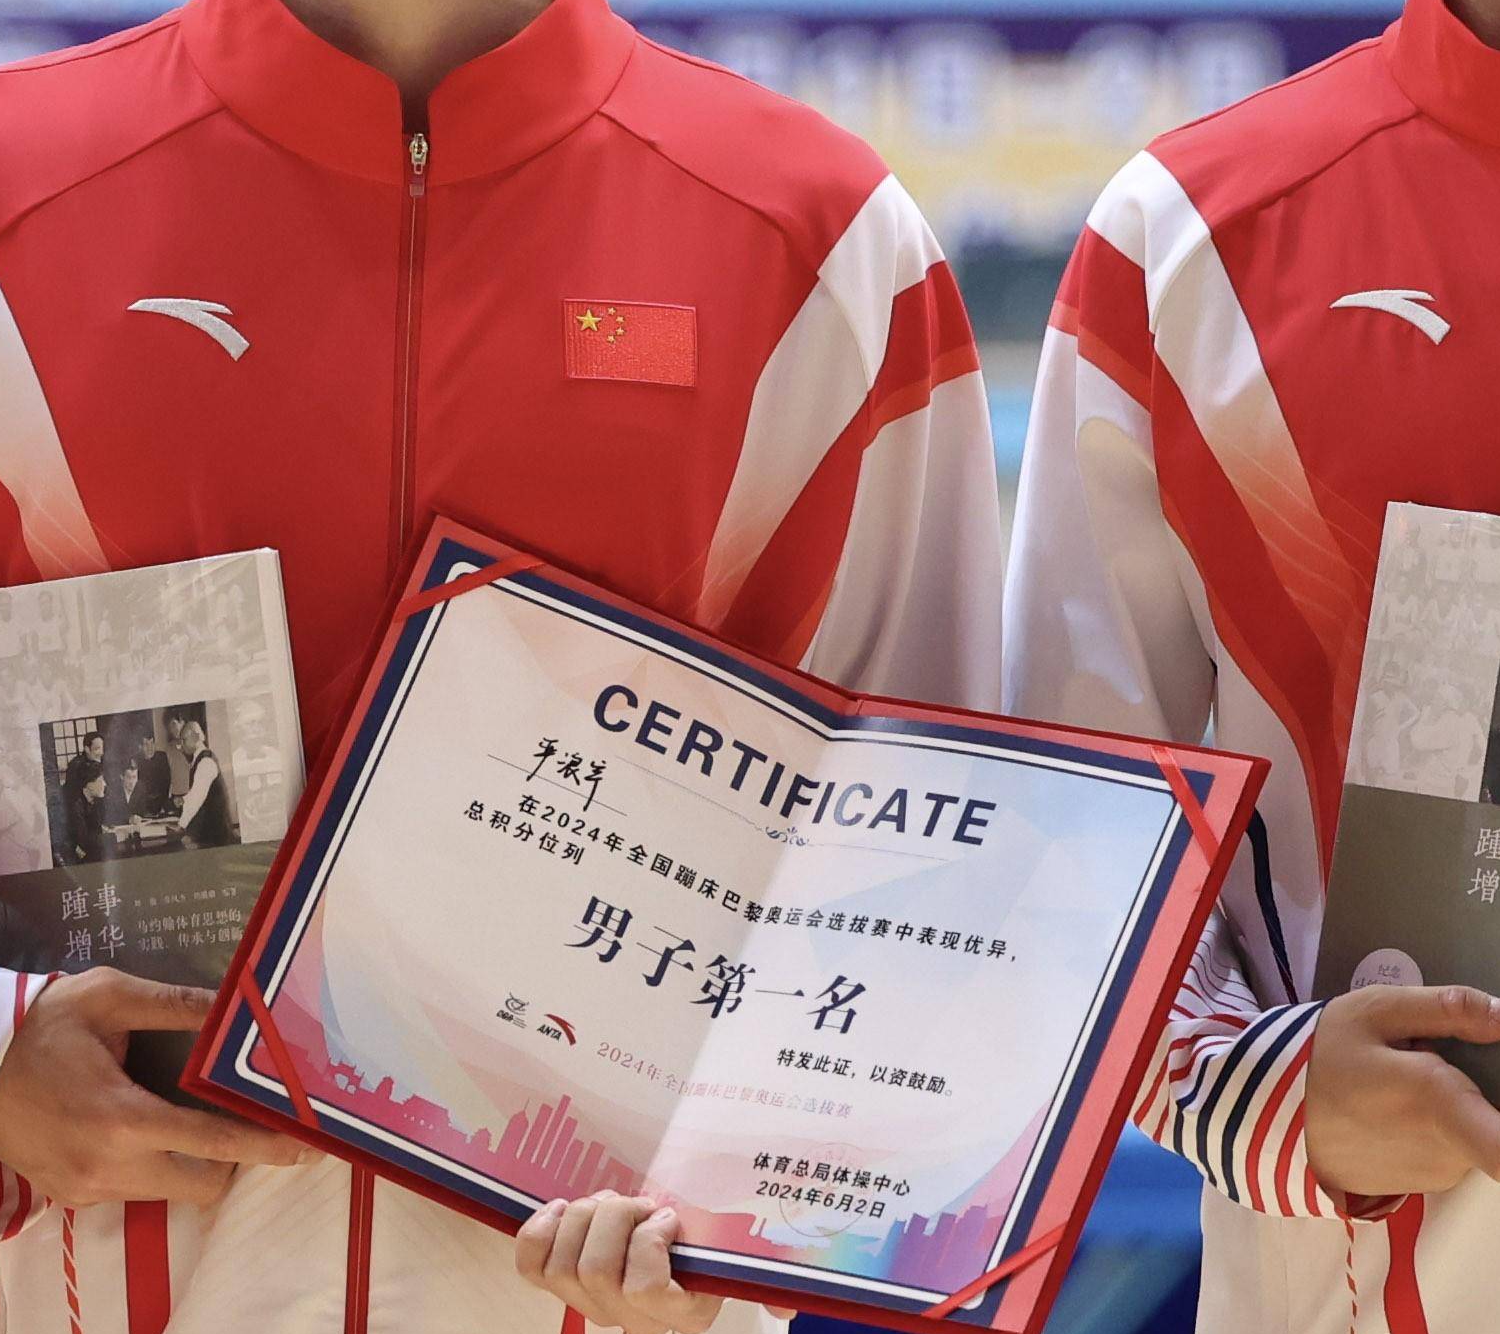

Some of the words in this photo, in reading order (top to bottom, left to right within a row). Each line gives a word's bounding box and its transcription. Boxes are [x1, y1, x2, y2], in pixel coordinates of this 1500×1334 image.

[593, 684, 996, 847] CERTIFICATE
[463, 800, 585, 865] 总积分位列
[65, 924, 126, 962] 增华
[564, 896, 866, 1035] 男子第一名
[537, 1024, 562, 1040] ANTA
[753, 1152, 911, 1196] 体育总局体操中心
[756, 1181, 886, 1218] 2024年6月2日
